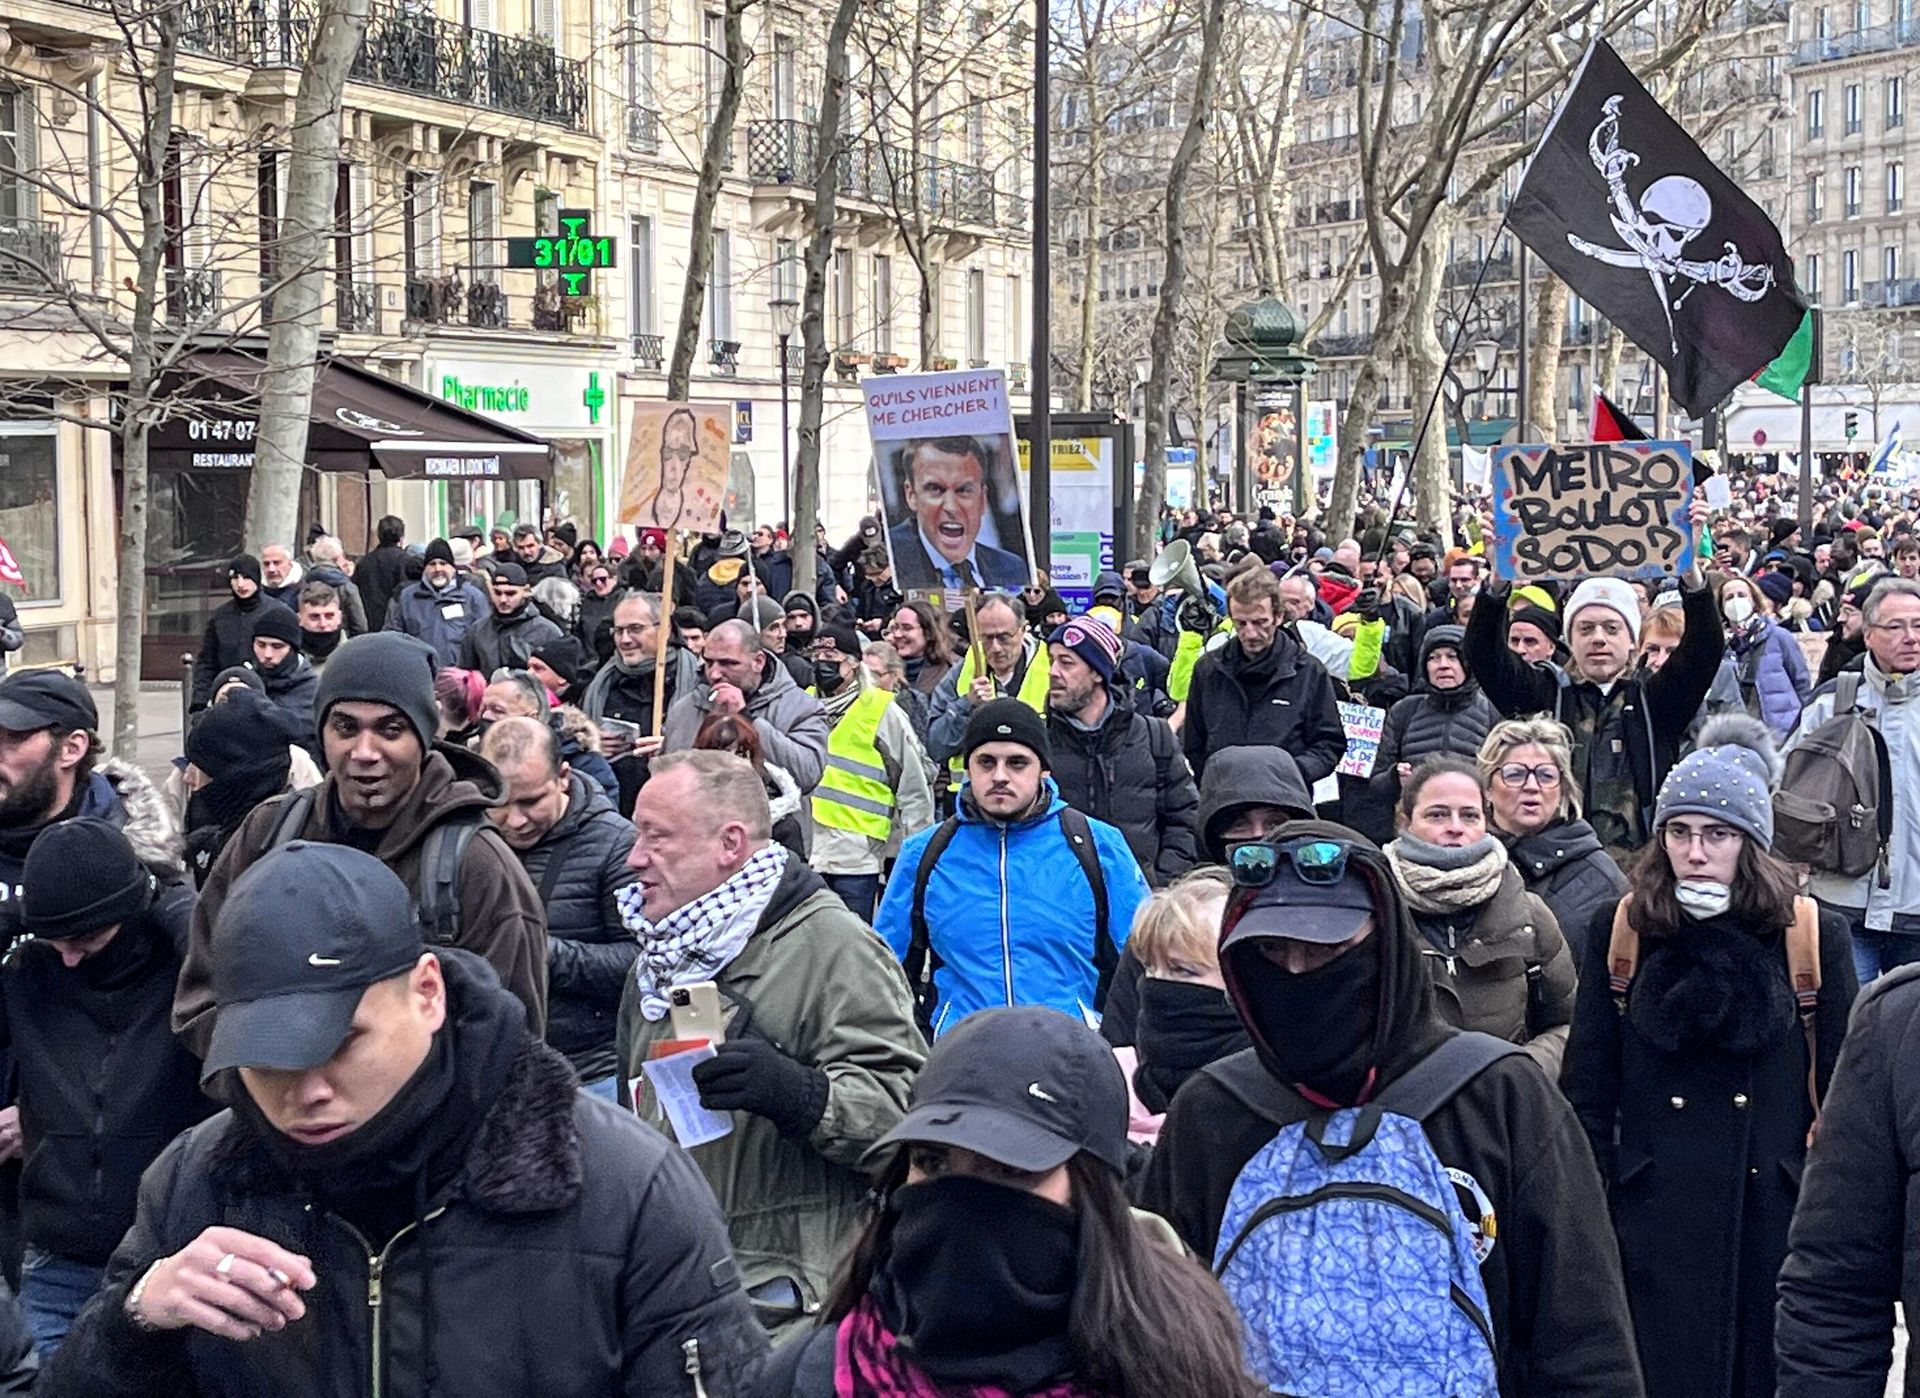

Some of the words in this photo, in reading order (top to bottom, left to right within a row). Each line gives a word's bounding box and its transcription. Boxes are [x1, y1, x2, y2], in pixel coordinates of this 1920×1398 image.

[534, 238, 610, 266] 31/01
[442, 374, 529, 412] Pharmacie
[870, 389, 916, 408] QU'ILS
[919, 377, 999, 401] VIENNENT
[873, 410, 896, 426] ME
[901, 398, 989, 424] CHERCHER
[189, 420, 208, 440] 01
[212, 420, 232, 440] 47
[235, 420, 256, 440] 07
[1510, 445, 1680, 500] METRO
